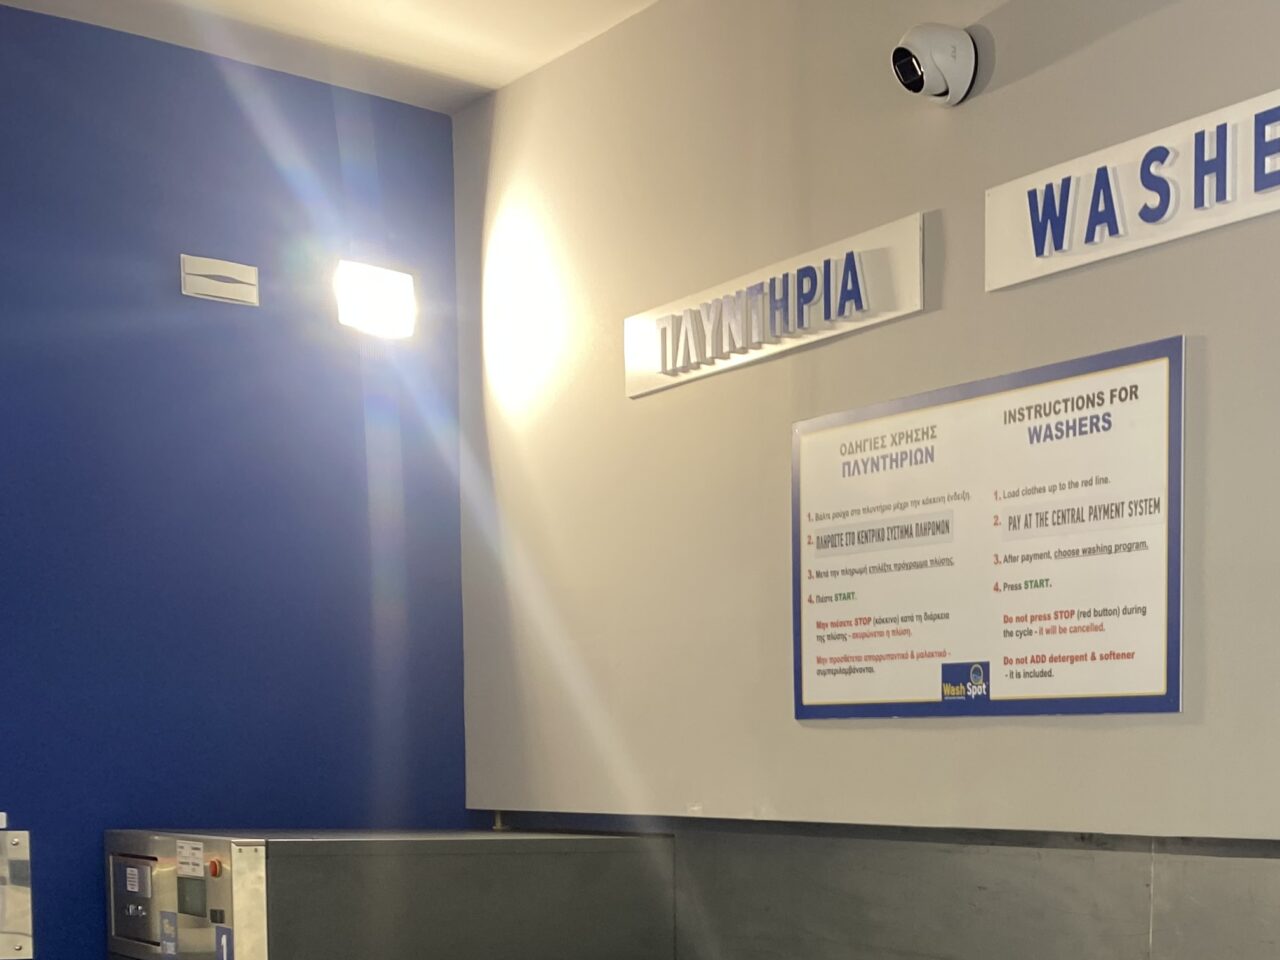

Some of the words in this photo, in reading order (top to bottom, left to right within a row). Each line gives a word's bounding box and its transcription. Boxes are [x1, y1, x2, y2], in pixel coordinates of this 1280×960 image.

[659, 252, 864, 375] ΠΛΥΝΤΗΡΙΑ
[1004, 391, 1105, 425] INSTRUCTIONS
[1110, 384, 1139, 405] FOR
[839, 434, 887, 457] ΟΔΗΓΙΕΣ
[890, 424, 937, 447] ΧΡΗΣΗΣ
[1028, 412, 1112, 445] WASHERS
[842, 445, 934, 478] ΠΛΥΝΤΗΡΙΩΝ
[994, 490, 1002, 501] 1.
[1002, 488, 1020, 500] Load
[1021, 486, 1046, 497] clothes
[1048, 484, 1058, 494] up
[1058, 482, 1066, 491] to
[1067, 480, 1080, 490] the
[1081, 476, 1094, 488] red
[1095, 476, 1111, 485] line.
[993, 514, 1002, 526] 2.
[1008, 515, 1021, 531] PAY
[1024, 513, 1032, 529] AT
[1035, 510, 1049, 528] THE
[1052, 506, 1086, 526] CENTRAL
[1088, 501, 1125, 522] PAYMENT
[1128, 497, 1160, 518] SYSTEM
[993, 553, 1002, 565] 3.
[1003, 554, 1019, 564] After
[1020, 550, 1052, 564] payment,
[1054, 548, 1080, 560] choose
[1082, 544, 1113, 556] washing
[1113, 540, 1149, 554] program.
[993, 582, 1002, 592] 4.
[1003, 582, 1022, 591] Press
[1024, 578, 1052, 590] START.
[1003, 614, 1014, 624] Do
[1015, 614, 1028, 623] not
[1030, 613, 1052, 624] press
[1053, 609, 1076, 620] STOP
[1076, 608, 1092, 620] (red
[1093, 606, 1120, 618] button)
[1122, 605, 1147, 616] during
[1003, 629, 1014, 638] the
[1015, 627, 1033, 639] cycle
[1045, 625, 1057, 635] will
[1058, 625, 1068, 635] be
[1068, 622, 1106, 634] cancelled.
[1003, 656, 1014, 666] Do
[1015, 656, 1028, 665] not
[1030, 654, 1047, 664] ADD
[1048, 653, 1088, 664] detergent
[1099, 650, 1135, 661] softener
